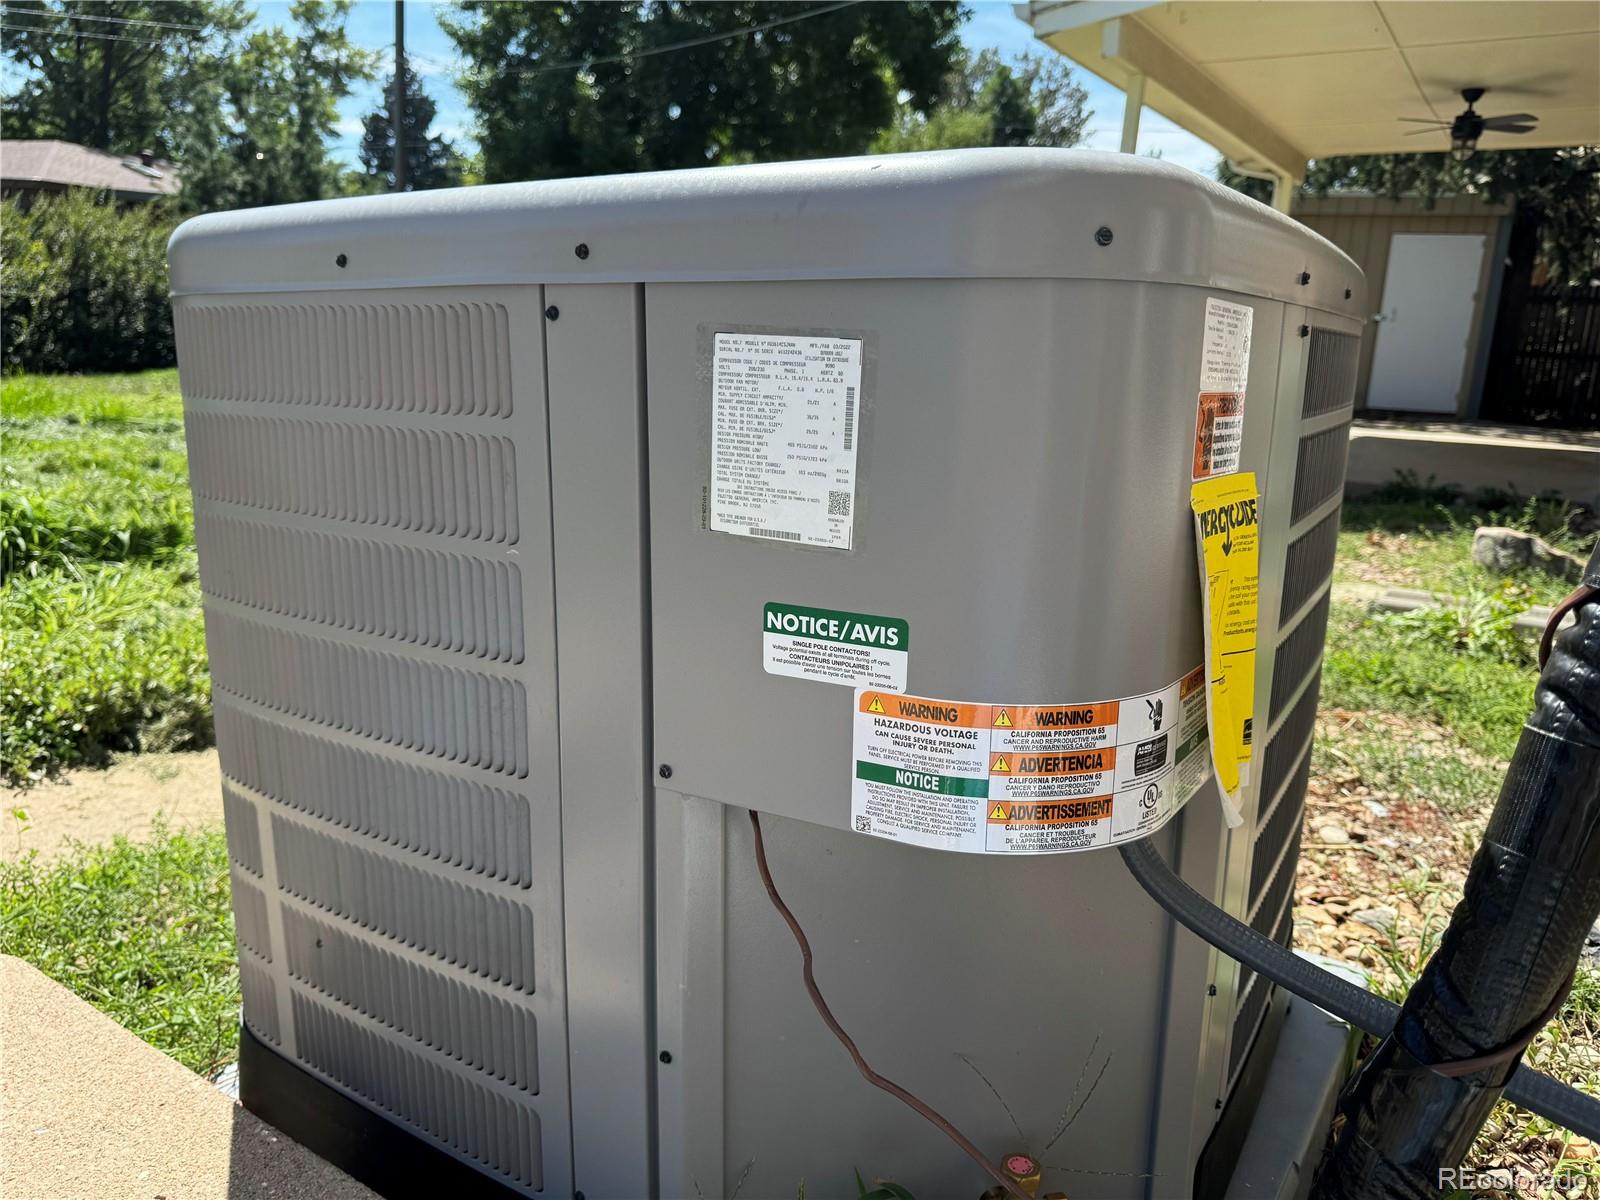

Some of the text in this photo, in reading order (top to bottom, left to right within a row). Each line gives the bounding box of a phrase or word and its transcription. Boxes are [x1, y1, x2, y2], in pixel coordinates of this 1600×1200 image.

[767, 611, 899, 646] NOTICE/AVIS
[772, 644, 788, 652] Voltage
[789, 646, 807, 655] potential
[834, 653, 854, 662] terminals
[855, 656, 870, 664] during
[792, 640, 812, 649] SINGLE
[829, 645, 870, 657] CONTACTORS!
[789, 653, 830, 665] CONTACTEURS
[832, 659, 870, 670] UNIPOLAIRES
[804, 668, 821, 676] pendant
[826, 664, 842, 673] tension
[852, 668, 866, 676] toutes
[875, 672, 891, 680] bornes
[898, 701, 958, 723] WARNING
[1035, 709, 1093, 727] WARNING
[874, 718, 978, 740] HAZARDOUS VOLTAGE
[1054, 728, 1096, 737] PROPOSITION
[875, 730, 976, 750] CAN CAUSE SEVERE PERSONAL
[892, 740, 916, 750] INJURY
[930, 746, 954, 755] DEATH.
[1013, 742, 1096, 751] WWW.P65WARNINGS.CA.GOV
[888, 748, 911, 758] ELECTRICAL
[912, 752, 927, 761] POWER
[945, 758, 971, 766] REMOVING
[919, 760, 944, 769] PERFORMED
[904, 763, 920, 771] SERVICE
[896, 770, 940, 790] NOTICE
[1051, 775, 1093, 783] PROPOSITION
[1056, 780, 1100, 790] REPRODUCTIVO
[867, 788, 896, 799] INSTRUCTIONS
[897, 794, 917, 803] PROVIDED
[886, 786, 903, 795] FOLLOW
[912, 791, 941, 801] INSTALLATION
[1011, 787, 1094, 797] WWW.P65WARNINGS.CA.GOV
[916, 803, 937, 812] IMPROPER
[1008, 798, 1112, 820] ADVERTISSEMENT
[1142, 807, 1157, 819] LISTED
[865, 810, 884, 819] PROPERTY
[914, 820, 930, 828] SERVICE
[866, 805, 884, 814] CAUSING
[895, 810, 912, 819] ELECTRIC
[930, 818, 952, 826] PERSONAL
[877, 818, 894, 827] CONSULT
[900, 823, 920, 832] QUALIFIED
[922, 828, 938, 836] SERVICE
[1047, 822, 1089, 830] PROPOSITION
[1010, 840, 1092, 850] WWW.P65WARNINGS.CA.GOV
[1050, 833, 1096, 843] REPRODUCTEUR
